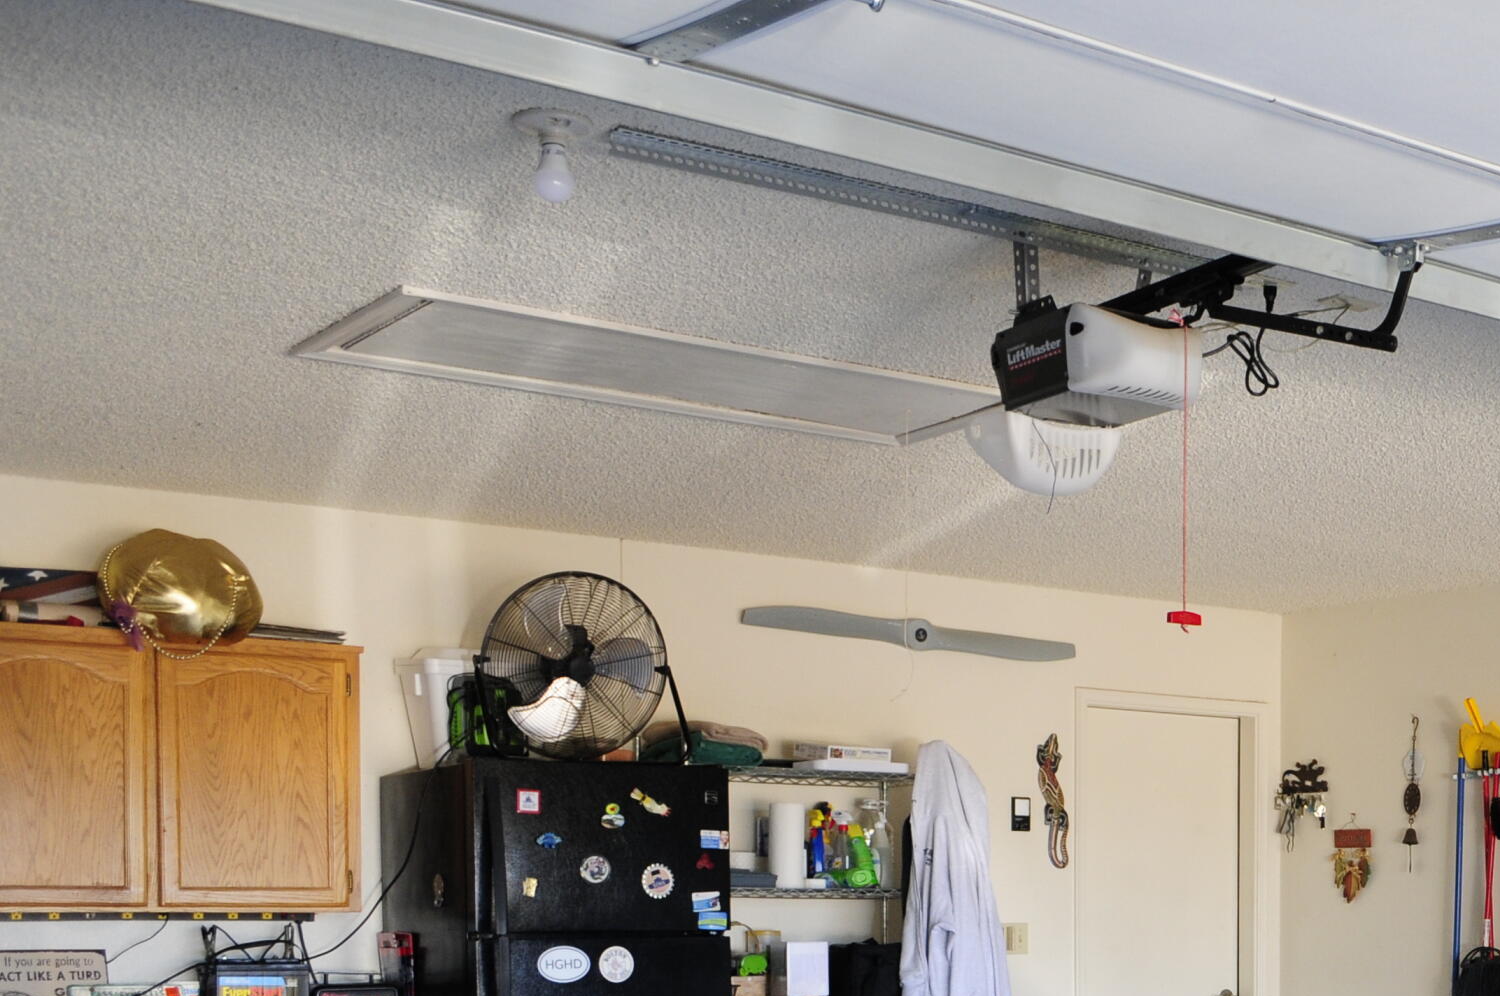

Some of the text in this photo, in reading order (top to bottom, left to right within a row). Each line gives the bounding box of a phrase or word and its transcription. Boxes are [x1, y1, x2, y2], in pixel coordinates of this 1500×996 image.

[1007, 339, 1062, 366] LiftMaster
[4, 957, 94, 969] If you are going to
[545, 958, 583, 971] HGHD
[0, 970, 101, 982] ACT LIKE A TURD
